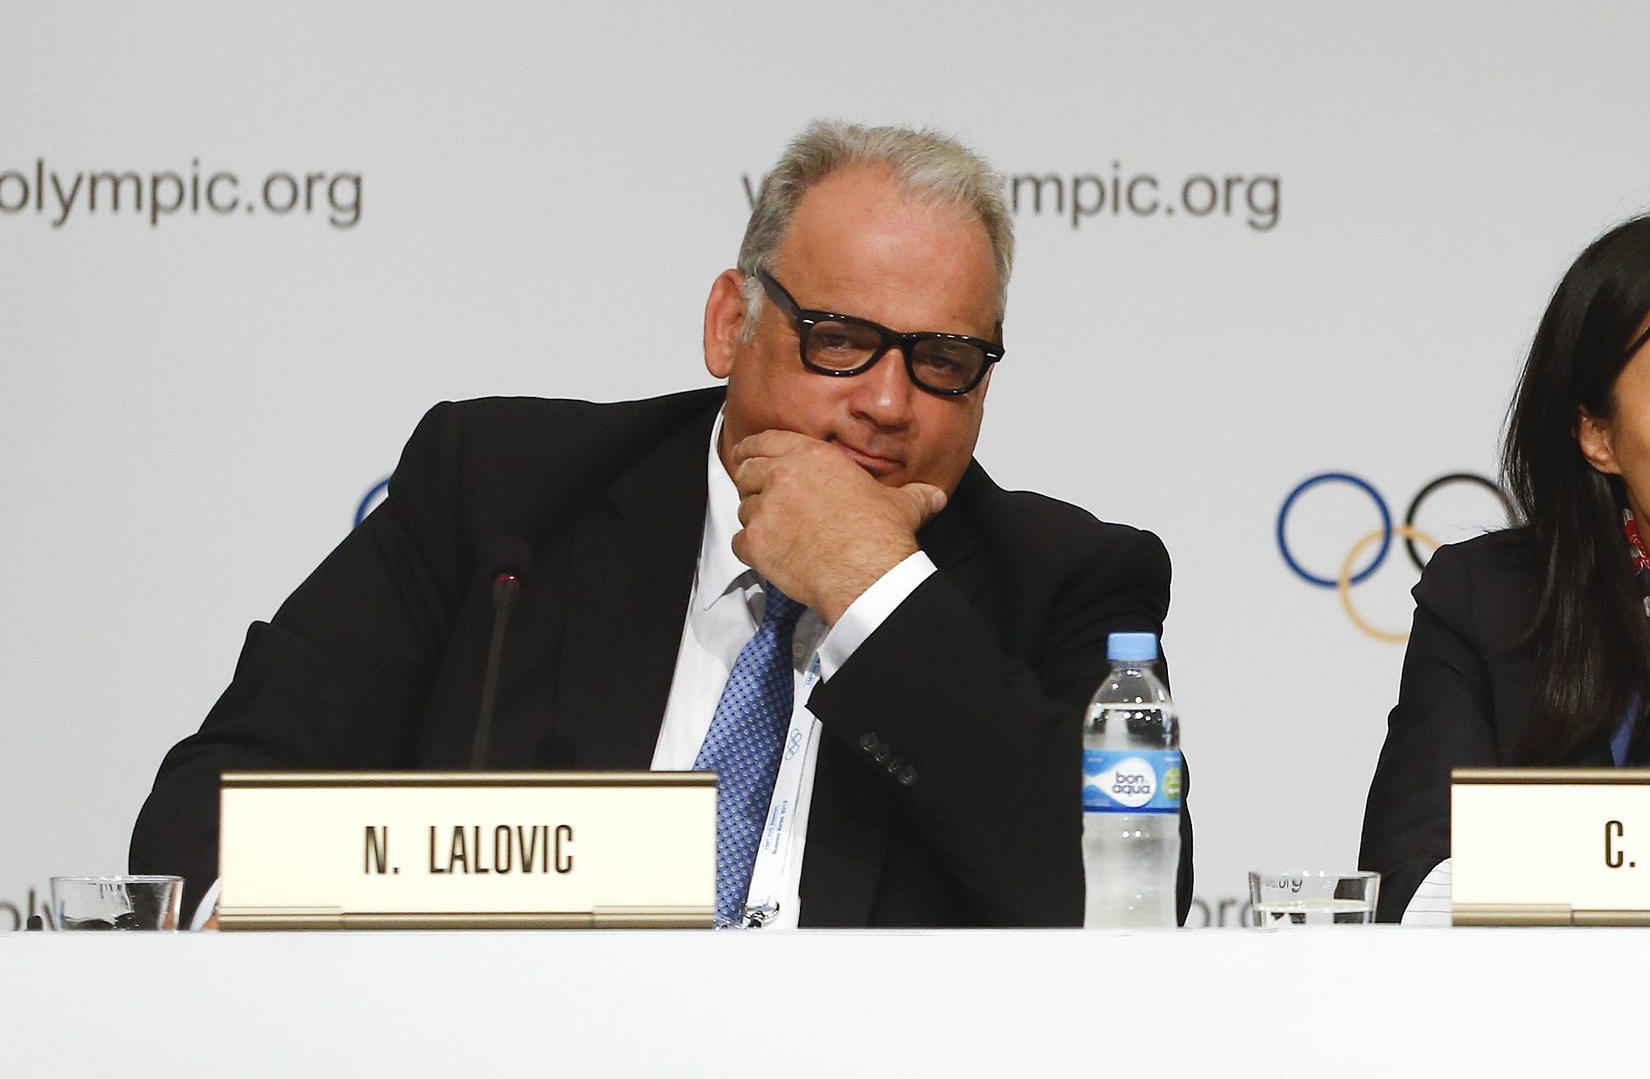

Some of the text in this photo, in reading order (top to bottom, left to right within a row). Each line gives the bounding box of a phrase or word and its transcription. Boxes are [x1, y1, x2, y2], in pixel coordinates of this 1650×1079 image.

[0, 157, 363, 231] olympic.org
[1112, 784, 1151, 797] aqua
[364, 824, 574, 875] N. LALOVIC
[1604, 820, 1636, 869] C.
